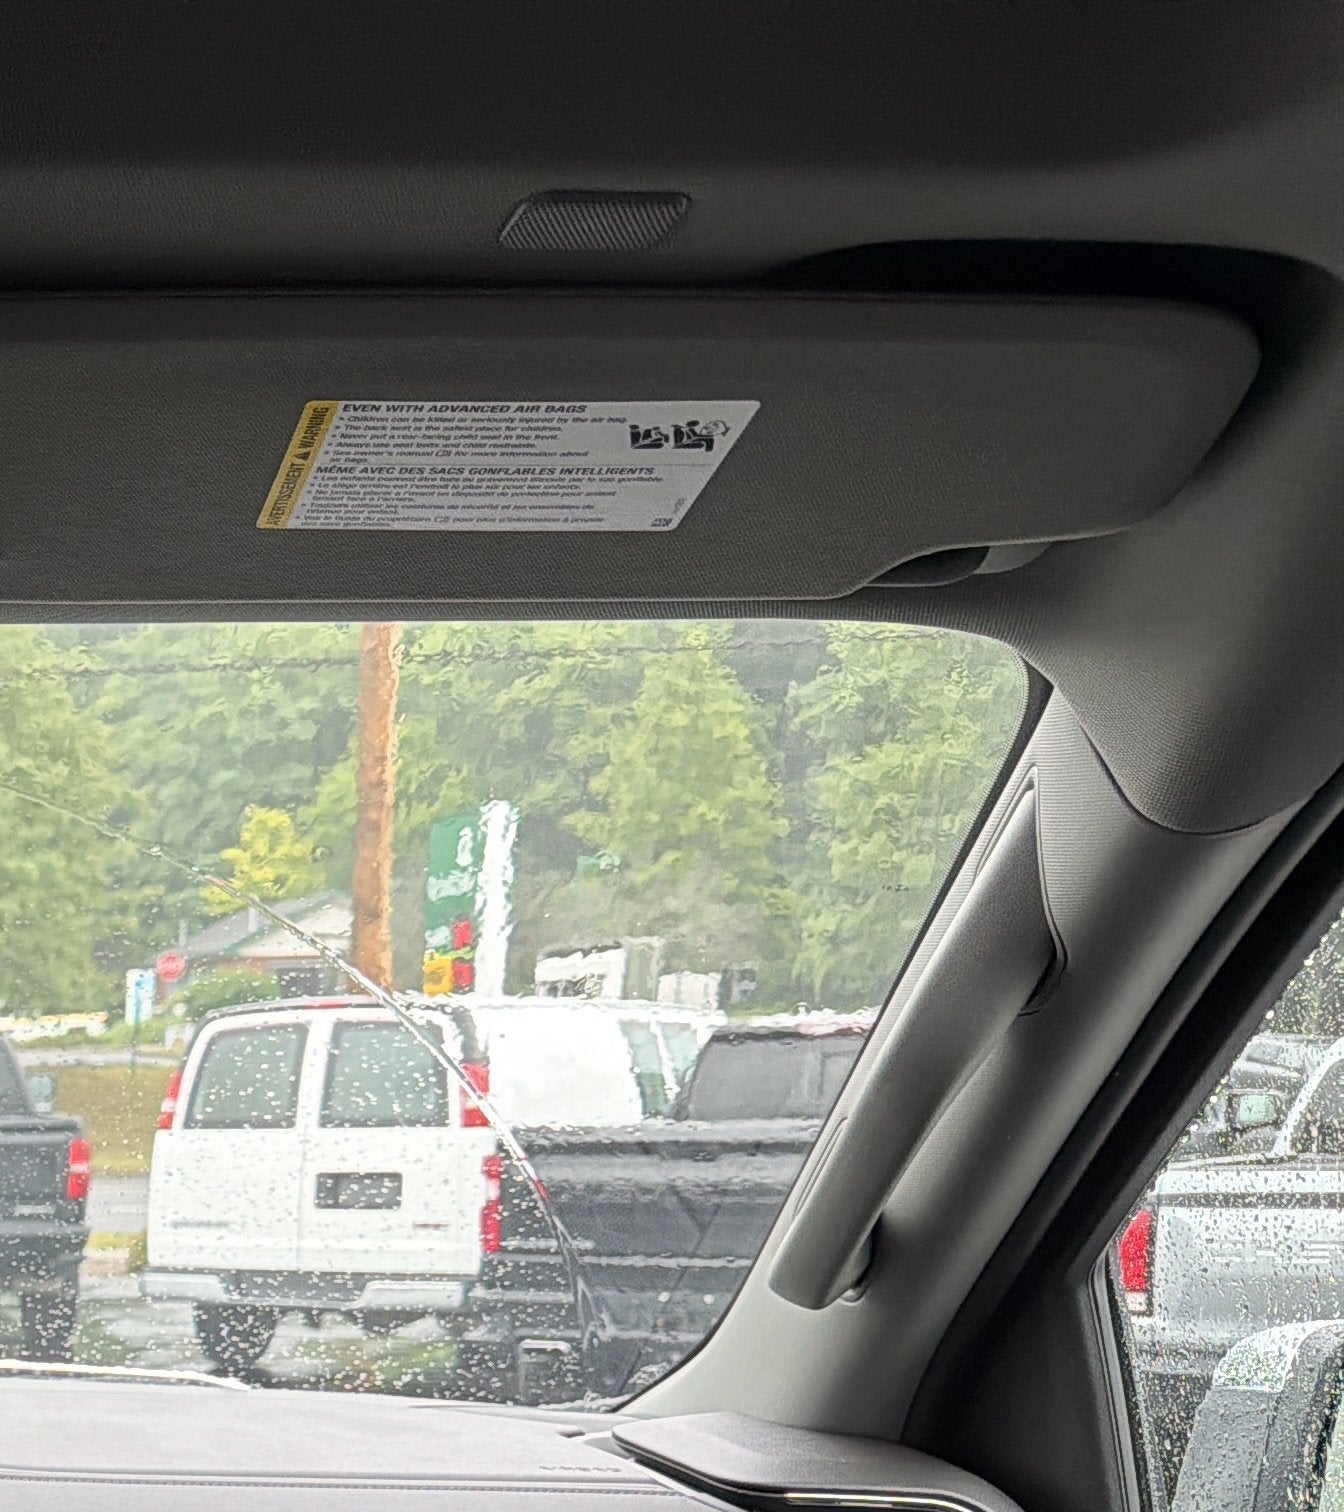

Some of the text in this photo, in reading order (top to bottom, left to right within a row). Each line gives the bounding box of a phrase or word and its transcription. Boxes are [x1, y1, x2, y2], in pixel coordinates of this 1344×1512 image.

[340, 404, 589, 413] EVEN WITH ADVANCED AIR BAGS
[314, 464, 657, 475] MÊME AVEC DES SACS GONFLABLES INTELLIGENTS
